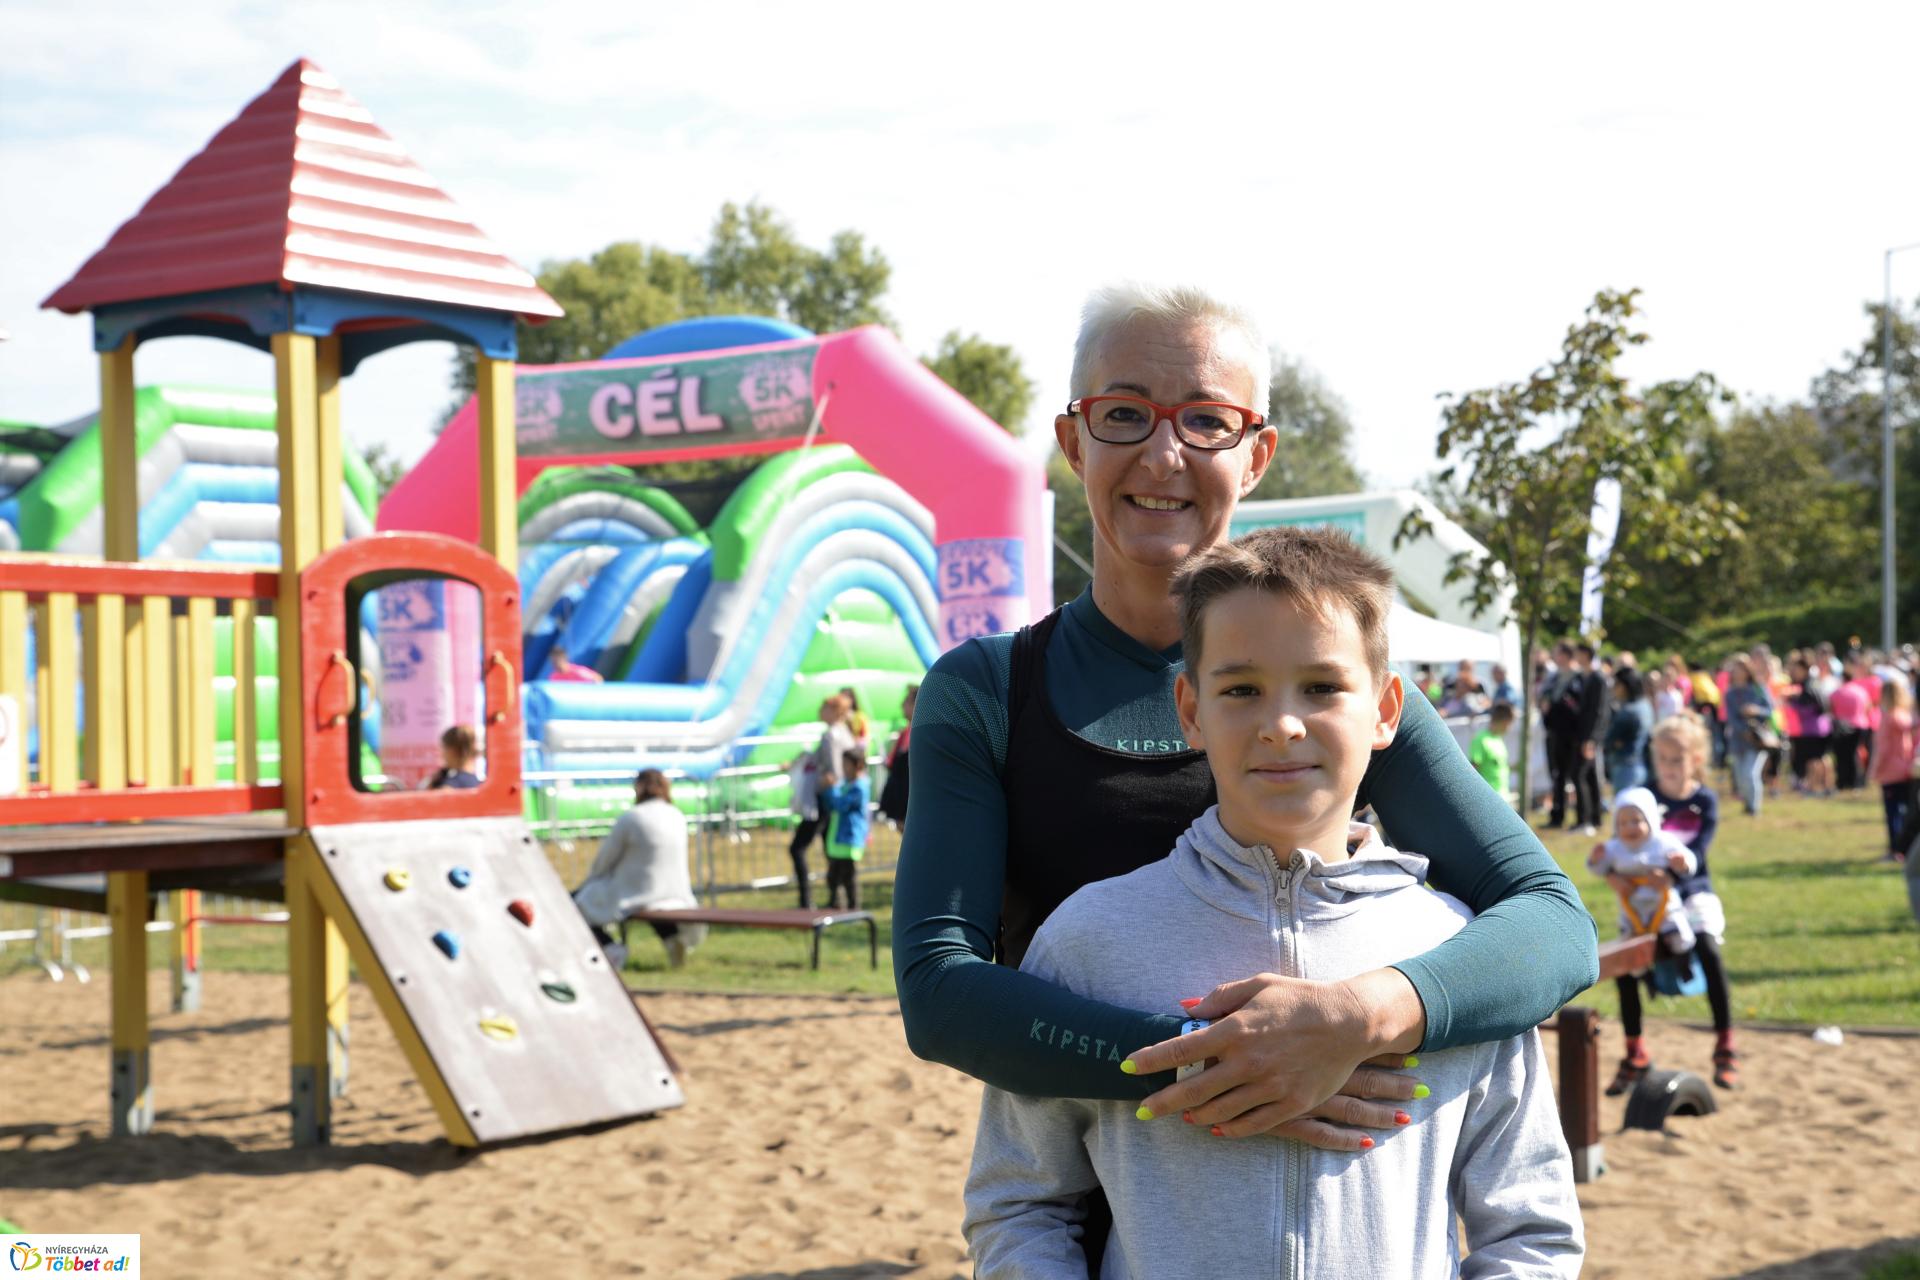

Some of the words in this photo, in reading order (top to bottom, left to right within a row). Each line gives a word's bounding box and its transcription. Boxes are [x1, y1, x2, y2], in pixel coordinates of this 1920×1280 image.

[589, 367, 723, 438] CÉL
[947, 560, 991, 589] 5K
[1116, 739, 1190, 751] KIPST
[1030, 1018, 1121, 1063] KIPSTA
